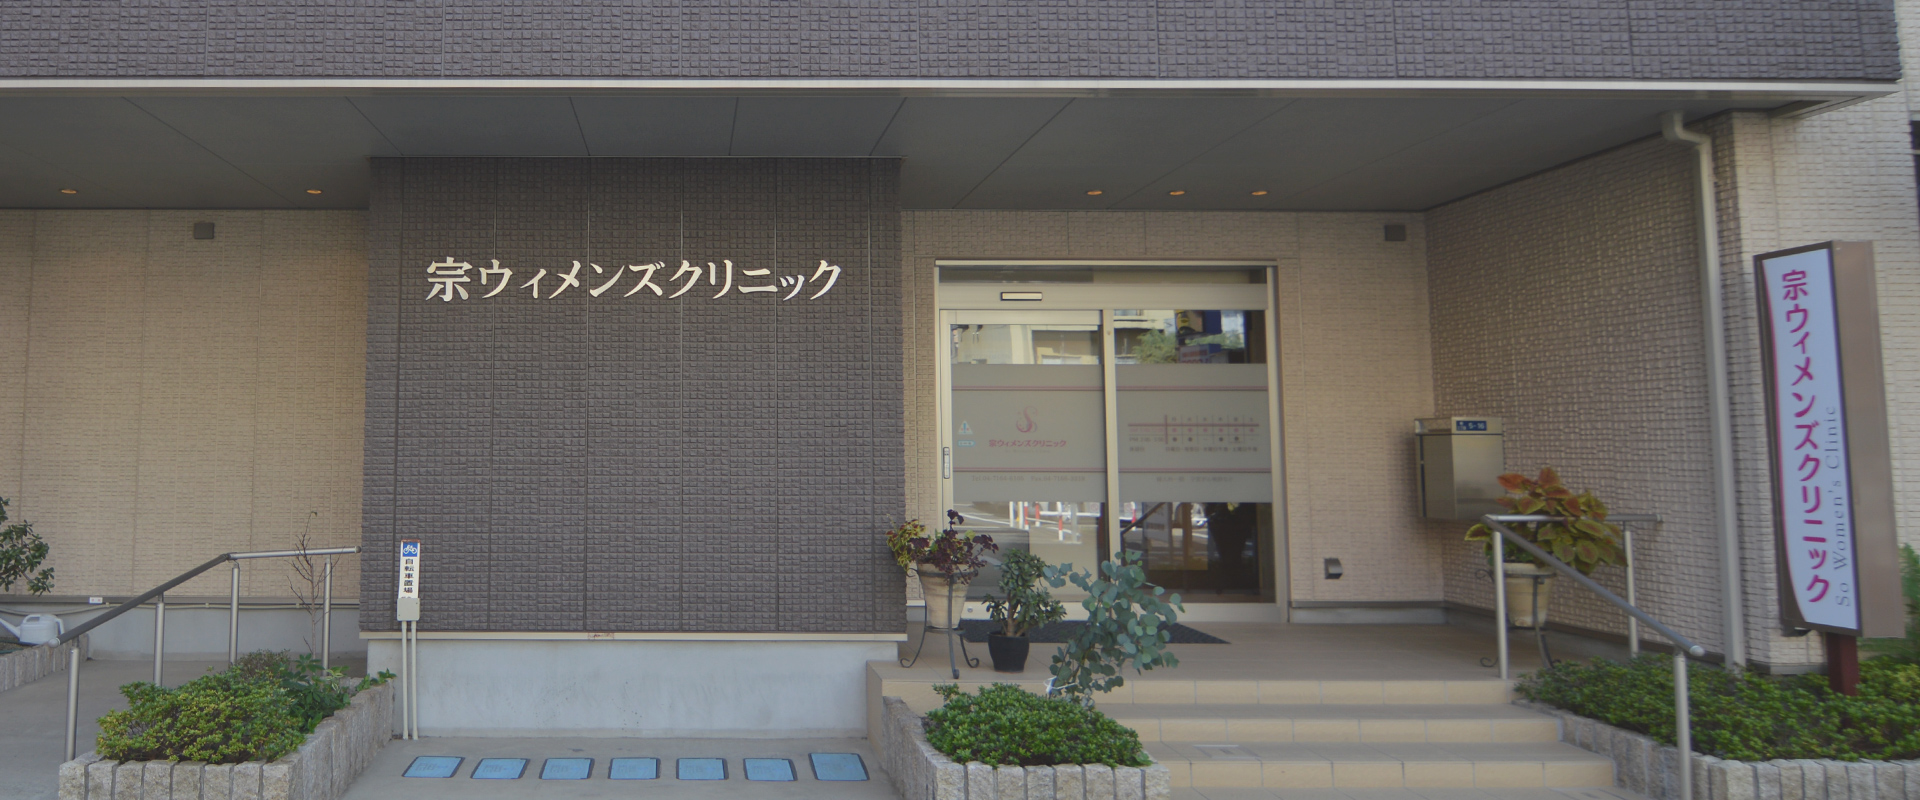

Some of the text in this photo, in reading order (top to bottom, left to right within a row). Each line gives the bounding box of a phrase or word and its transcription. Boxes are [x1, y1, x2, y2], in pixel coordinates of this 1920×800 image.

[425, 256, 842, 302] 宗ウィメンズクリニック
[988, 439, 1067, 448] 宗ウィメンズクリニック
[1781, 269, 1830, 603] 宗ウィメンズクリニック
[1824, 406, 1850, 607] So Women's Clinic
